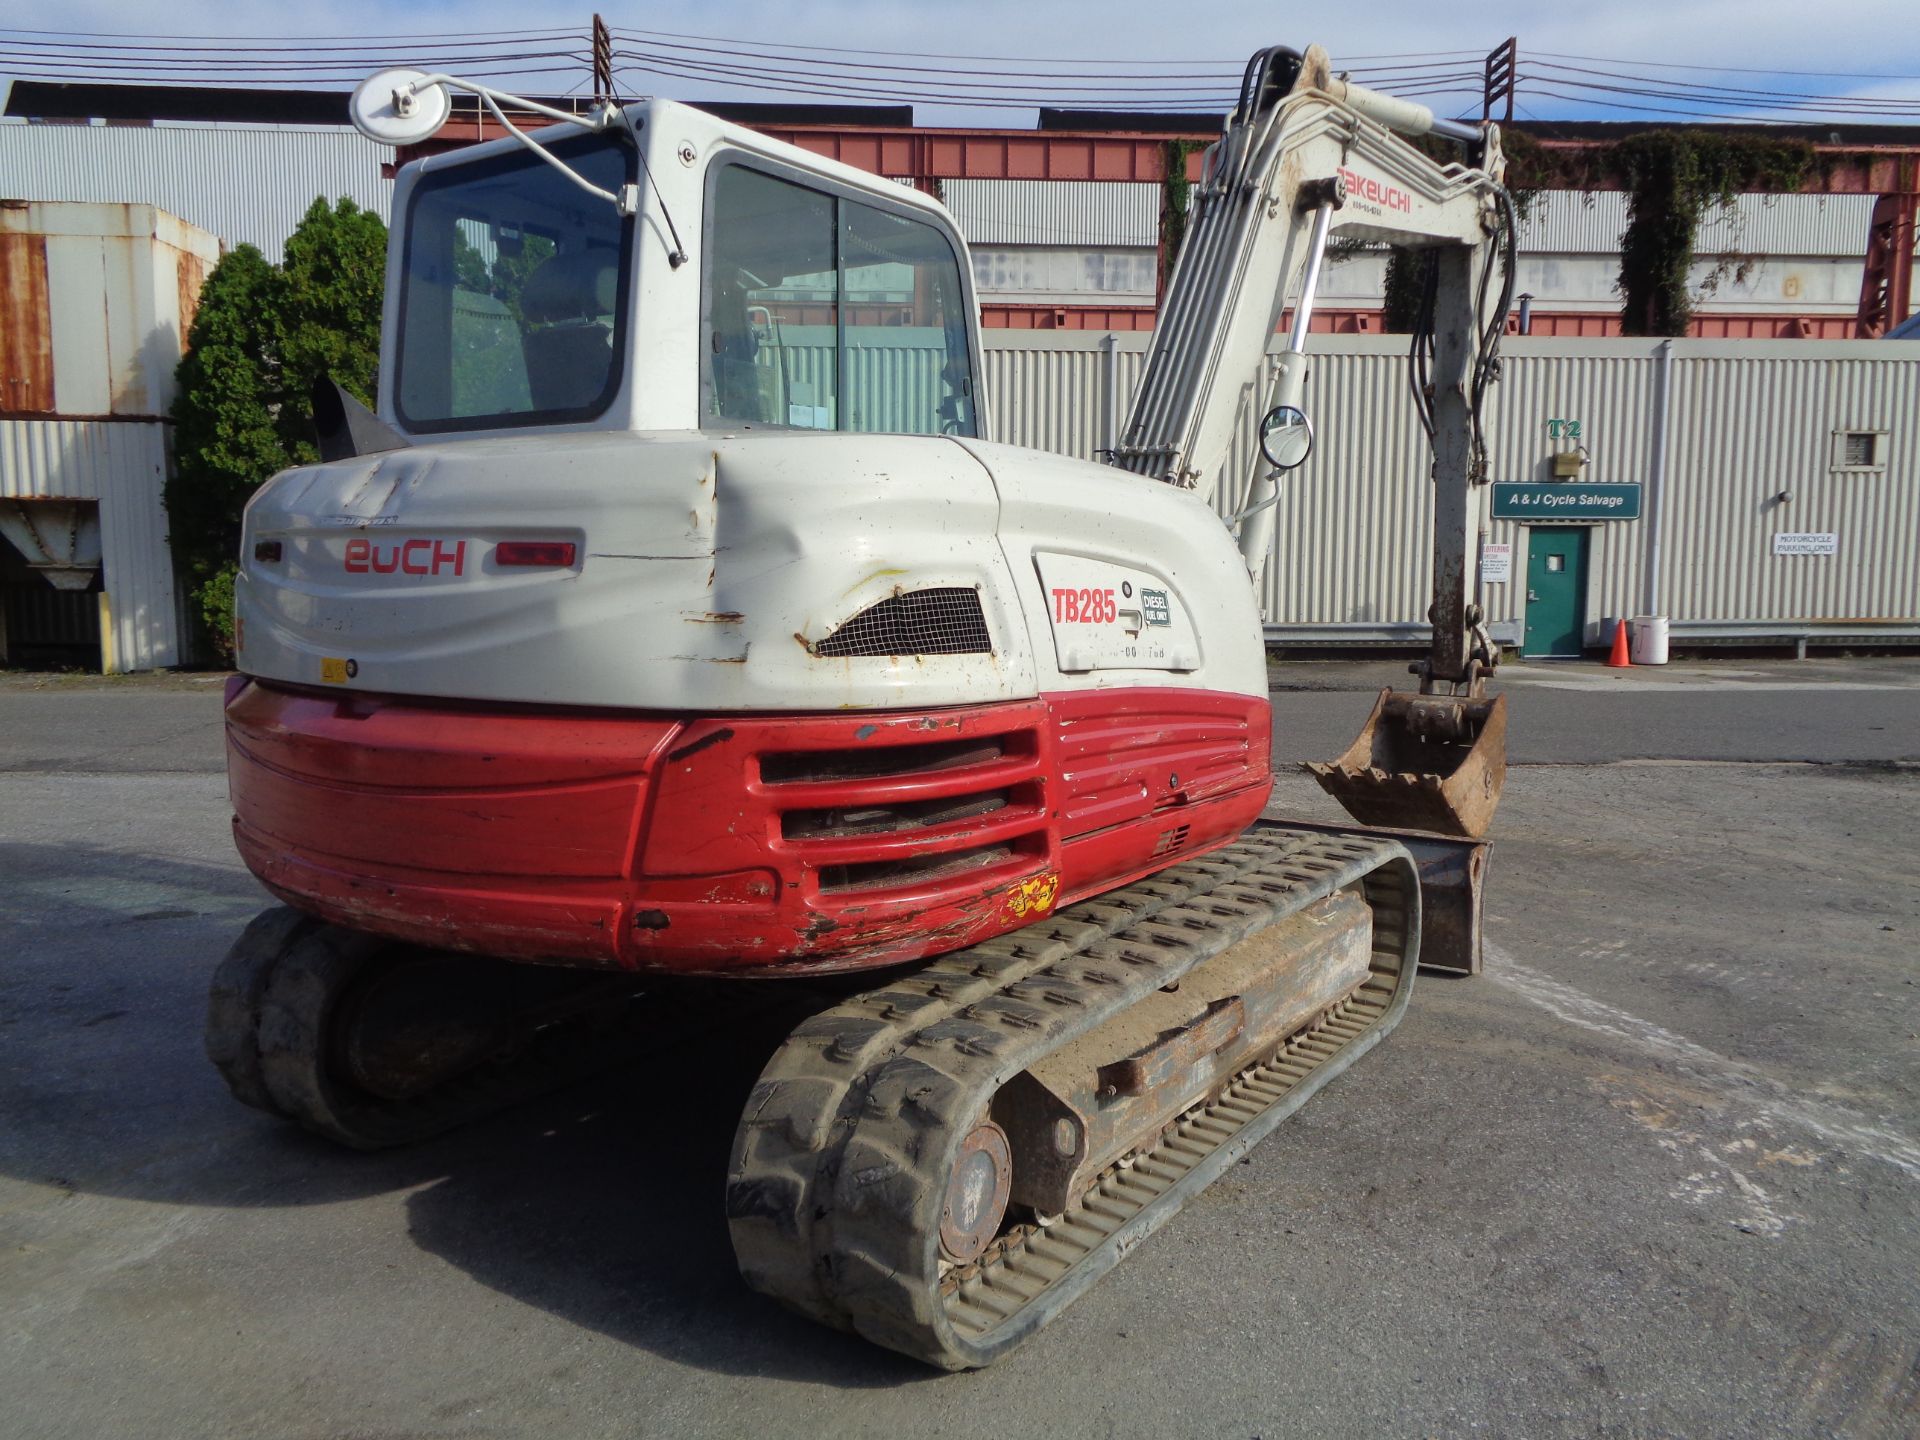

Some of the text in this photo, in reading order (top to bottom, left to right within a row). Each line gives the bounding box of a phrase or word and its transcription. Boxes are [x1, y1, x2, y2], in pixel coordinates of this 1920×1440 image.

[1509, 493, 1625, 508] A & J Cycle Salvage
[1780, 535, 1832, 543] MOTORCYCLE
[1777, 544, 1835, 552] PARKING ONLY
[1052, 588, 1116, 624] TB285
[1143, 595, 1167, 609] DIESEL
[1145, 610, 1168, 621] FUEL ONLY
